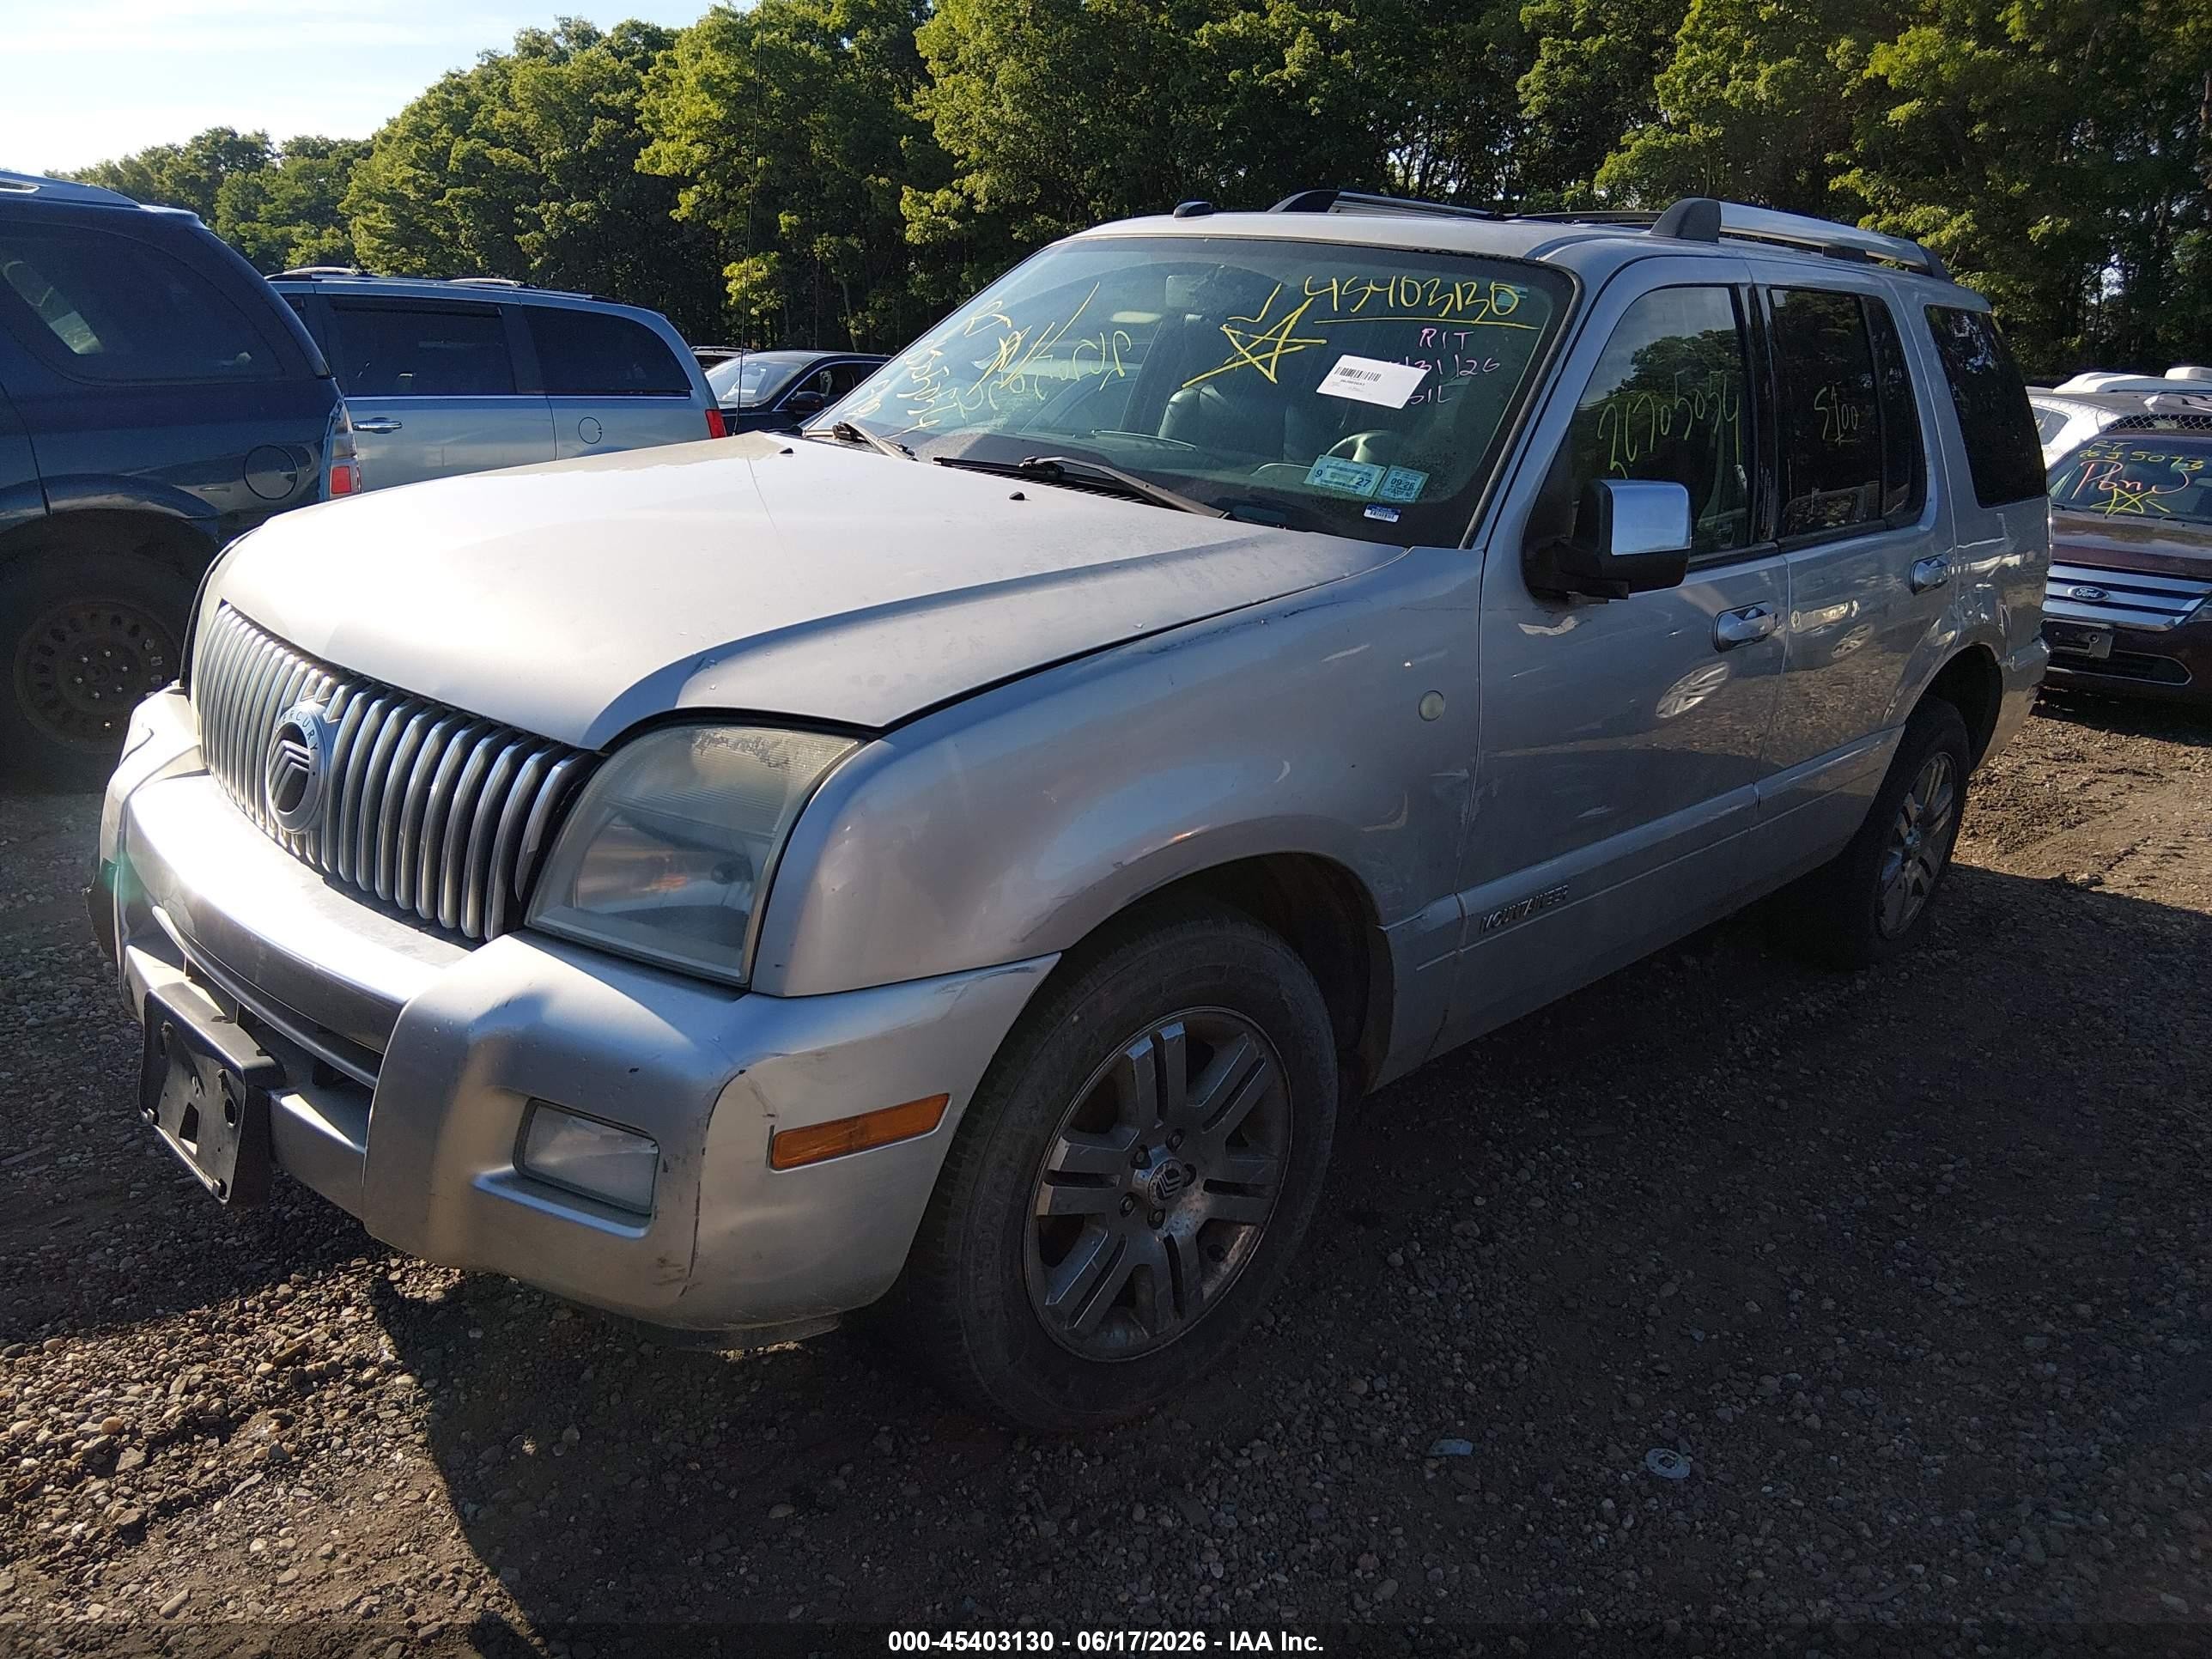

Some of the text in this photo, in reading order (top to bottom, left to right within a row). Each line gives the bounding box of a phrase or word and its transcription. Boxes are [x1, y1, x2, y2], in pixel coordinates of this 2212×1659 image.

[1304, 275, 1519, 325] 45403130
[1355, 477, 1371, 488] 27
[2076, 587, 2100, 599] Ford
